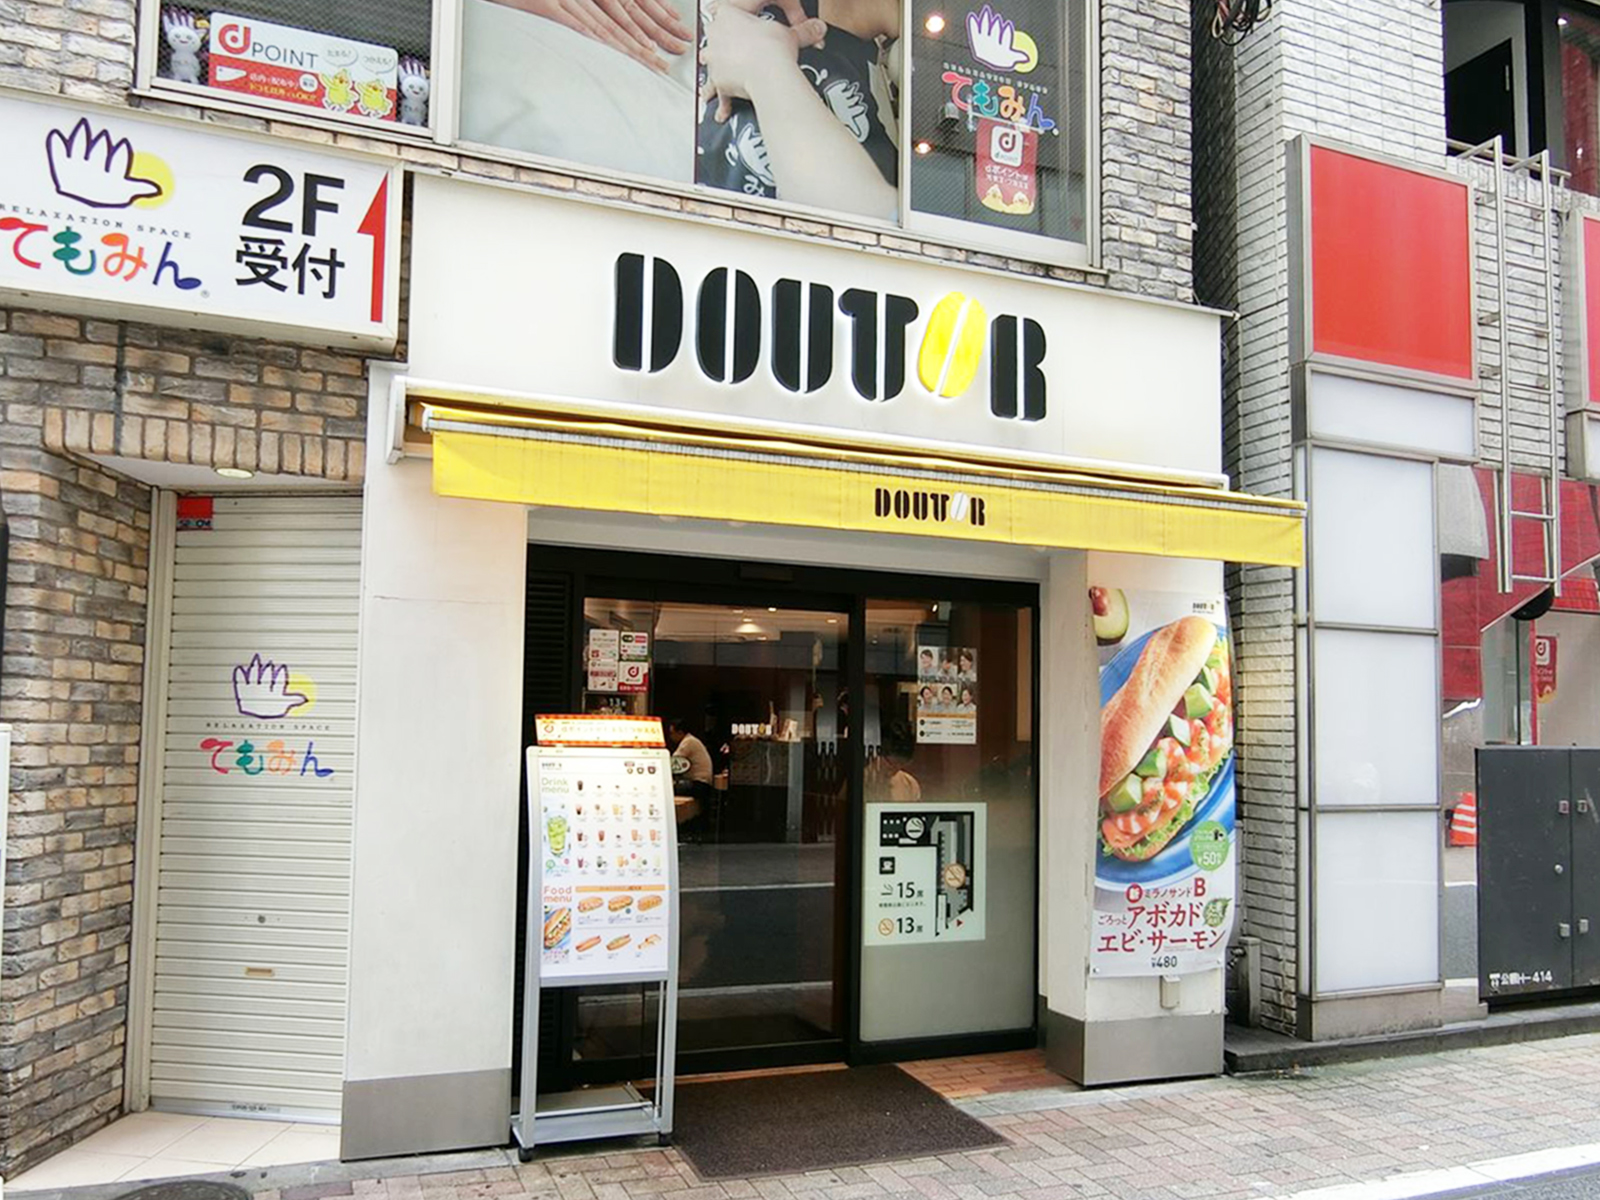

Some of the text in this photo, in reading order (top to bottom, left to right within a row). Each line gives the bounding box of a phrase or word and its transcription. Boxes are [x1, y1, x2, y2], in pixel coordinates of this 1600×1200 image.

[252, 42, 319, 69] POINT
[941, 71, 1055, 131] てもみん
[242, 164, 345, 237] 2F
[0, 203, 192, 240] RELAXATION SPACE
[0, 217, 202, 290] てもみん
[235, 235, 346, 299] 受付
[613, 252, 1047, 421] DOUTOR
[874, 487, 986, 526] DOUTOR
[200, 738, 335, 778] てもみん
[544, 885, 572, 895] Food
[544, 895, 572, 903] menu
[1194, 878, 1207, 898] B
[1127, 901, 1204, 930] アボカド
[1097, 928, 1227, 955] エビ・サーモン
